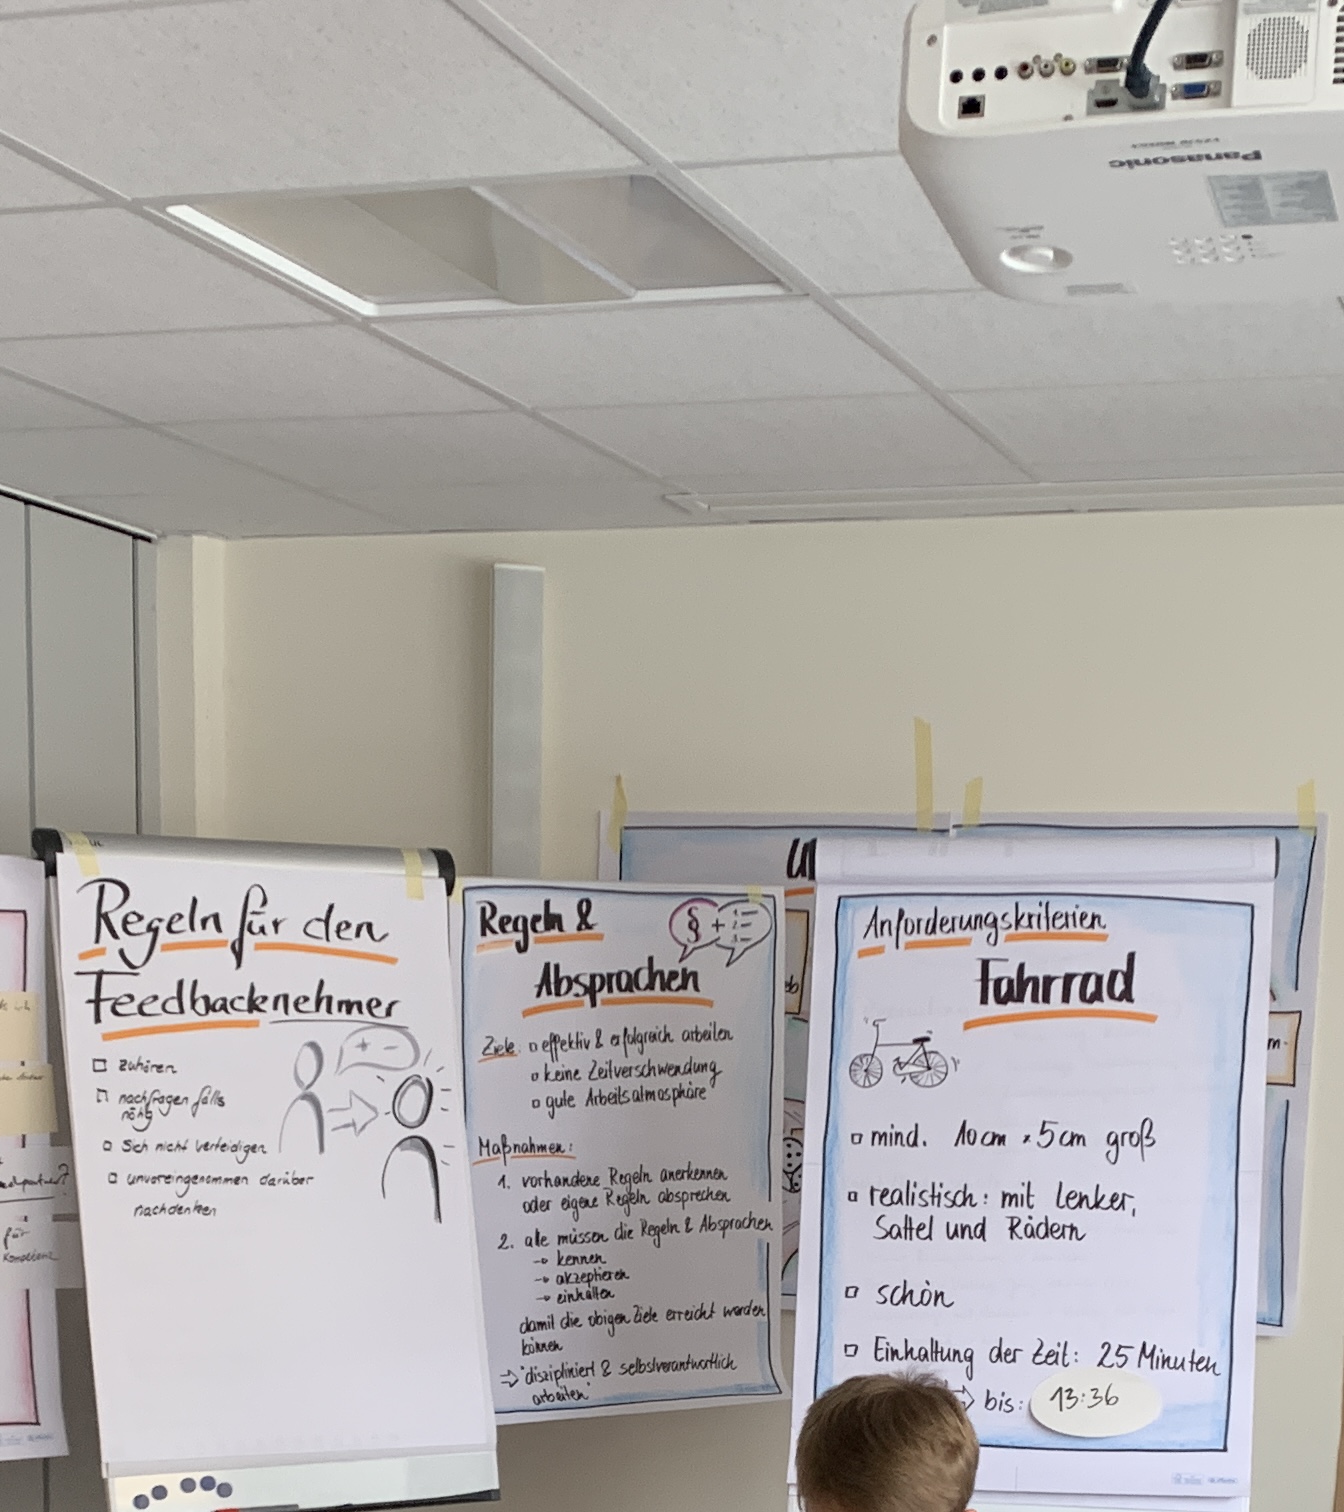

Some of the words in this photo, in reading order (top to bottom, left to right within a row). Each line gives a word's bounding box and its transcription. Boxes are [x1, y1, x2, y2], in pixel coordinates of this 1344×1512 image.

[1108, 150, 1263, 170] Panasonic
[77, 878, 223, 969] Regeln
[230, 884, 285, 969] für
[302, 903, 388, 942] den
[476, 900, 564, 953] Regeln
[577, 898, 597, 930] &
[862, 902, 1106, 950] Anforderungskriterien
[535, 956, 701, 1008] Absprachen
[976, 952, 1136, 1005] Fahrrad
[74, 969, 401, 1023] Feedbacknehmer
[542, 1032, 591, 1062] effektiv
[595, 1029, 603, 1049] &
[611, 1024, 674, 1057] erfolgreich
[681, 1022, 733, 1042] arbeiten
[544, 1065, 582, 1082] keine
[587, 1056, 723, 1088] Zeitverschwendung
[119, 1089, 189, 1116] nachfragen
[192, 1086, 226, 1117] falls
[546, 1090, 575, 1119] gute
[586, 1082, 706, 1108] Arbeitsatmosphäre
[156, 1139, 189, 1152] nicht
[870, 1120, 927, 1149] mind.
[1106, 1118, 1157, 1165] groß
[126, 1172, 248, 1197] unvoreingenommen
[259, 1172, 314, 1186] darüber
[498, 1176, 511, 1190] 1.
[522, 1168, 600, 1188] vorhandene
[608, 1165, 652, 1195] Regeln
[660, 1162, 728, 1181] anerkennen
[134, 1205, 217, 1217] nachdenken
[523, 1199, 552, 1213] oder
[561, 1193, 599, 1220] eigene
[604, 1187, 650, 1217] Regeln
[658, 1189, 730, 1210] absprechen
[870, 1181, 988, 1209] realistisch:
[1000, 1182, 1035, 1209] mit
[1056, 1184, 1137, 1216] Lenker,
[498, 1235, 514, 1249] 2.
[525, 1231, 550, 1247] alle
[557, 1231, 609, 1245] müssen
[615, 1223, 634, 1240] die
[641, 1217, 680, 1248] Regeln
[699, 1211, 773, 1237] Absprachen
[873, 1218, 933, 1241] Sattel
[946, 1217, 986, 1241] und
[1008, 1215, 1086, 1241] Rädern
[557, 1251, 606, 1265] kennen
[556, 1267, 630, 1289] akzeptieren
[557, 1286, 615, 1304] einhalten
[876, 1282, 954, 1308] schön
[520, 1312, 555, 1333] damit
[561, 1311, 582, 1328] die
[589, 1309, 630, 1337] obigen
[633, 1306, 658, 1323] Ziele
[666, 1303, 716, 1321] erreicht
[723, 1300, 766, 1318] werden
[522, 1338, 563, 1355] können
[873, 1337, 974, 1381] Einhaltung
[988, 1338, 1022, 1365] der
[1032, 1338, 1079, 1368] Zeit:
[1097, 1341, 1135, 1369] 25
[1139, 1346, 1221, 1376] Minuten
[601, 1360, 612, 1377] &
[619, 1354, 737, 1374] selbstverantwortlich
[985, 1389, 1023, 1413] bis:
[1050, 1384, 1119, 1412] 13:36
